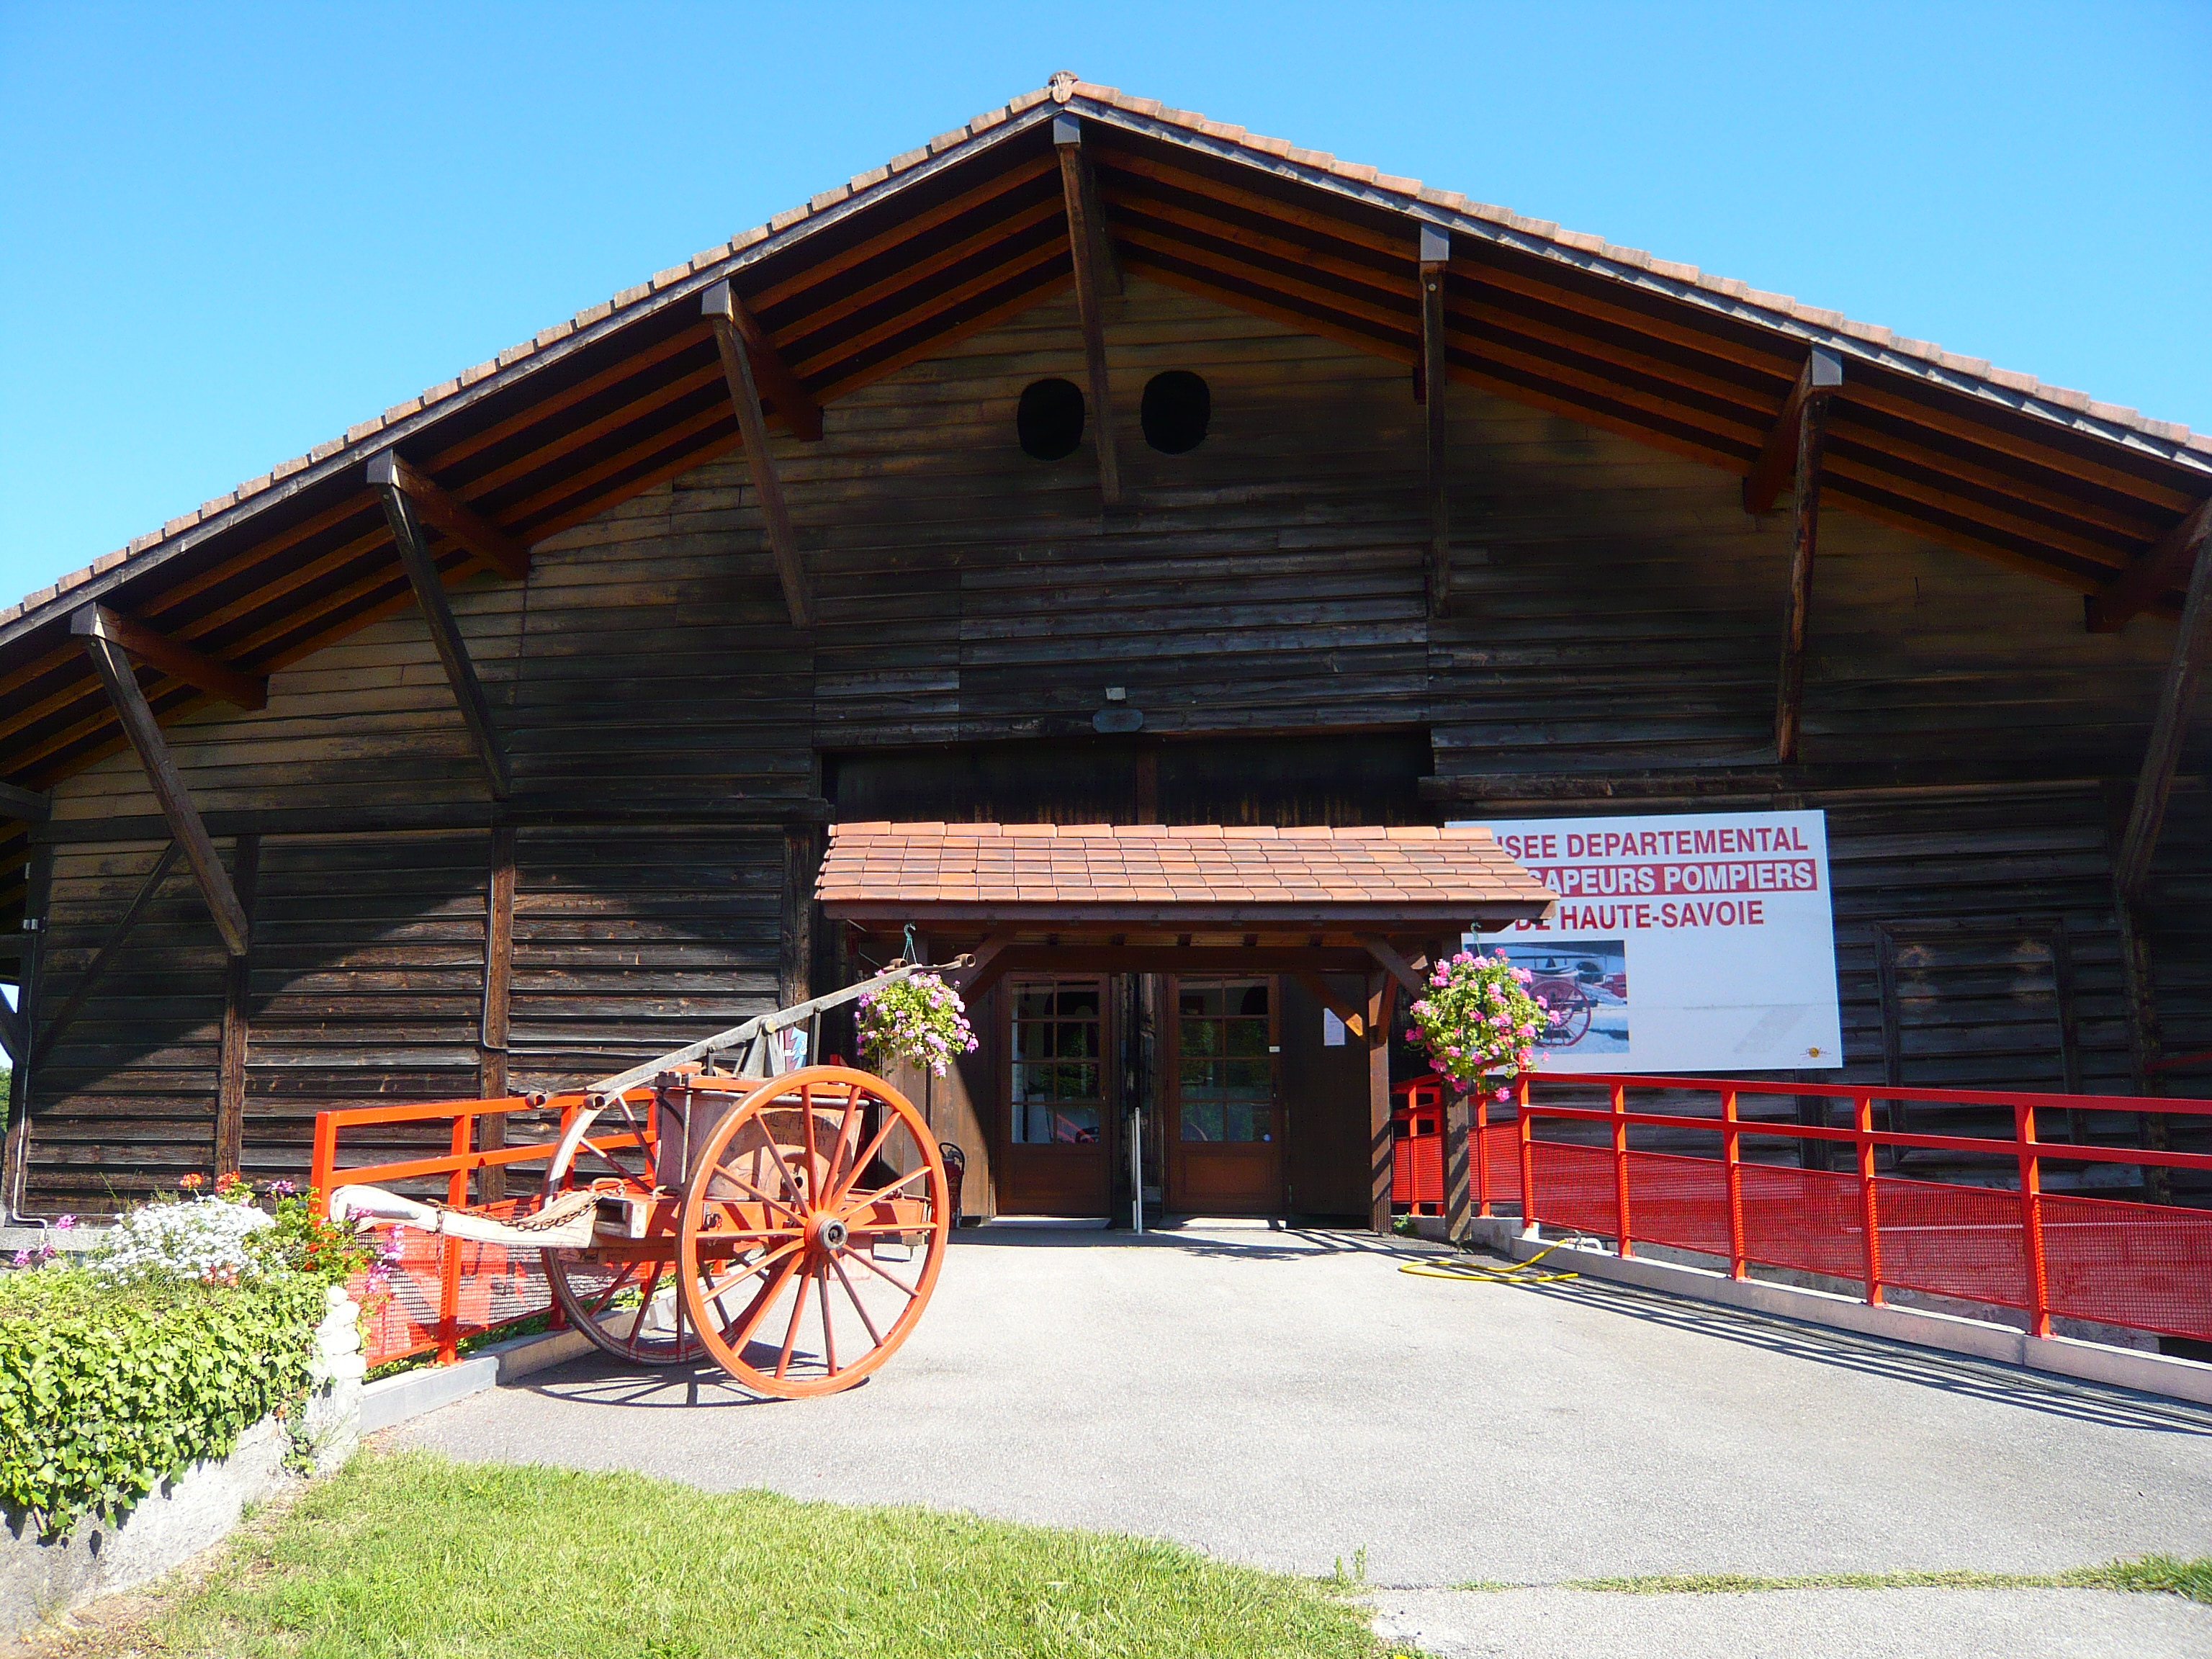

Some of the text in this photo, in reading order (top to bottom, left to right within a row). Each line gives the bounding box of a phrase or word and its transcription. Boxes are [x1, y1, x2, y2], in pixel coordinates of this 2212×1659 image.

[1497, 827, 1808, 860] SEE DEPARTEMENTAL
[1663, 861, 1812, 892] POMPIERS
[1560, 900, 1764, 930] HAUTE-SAVOIE
